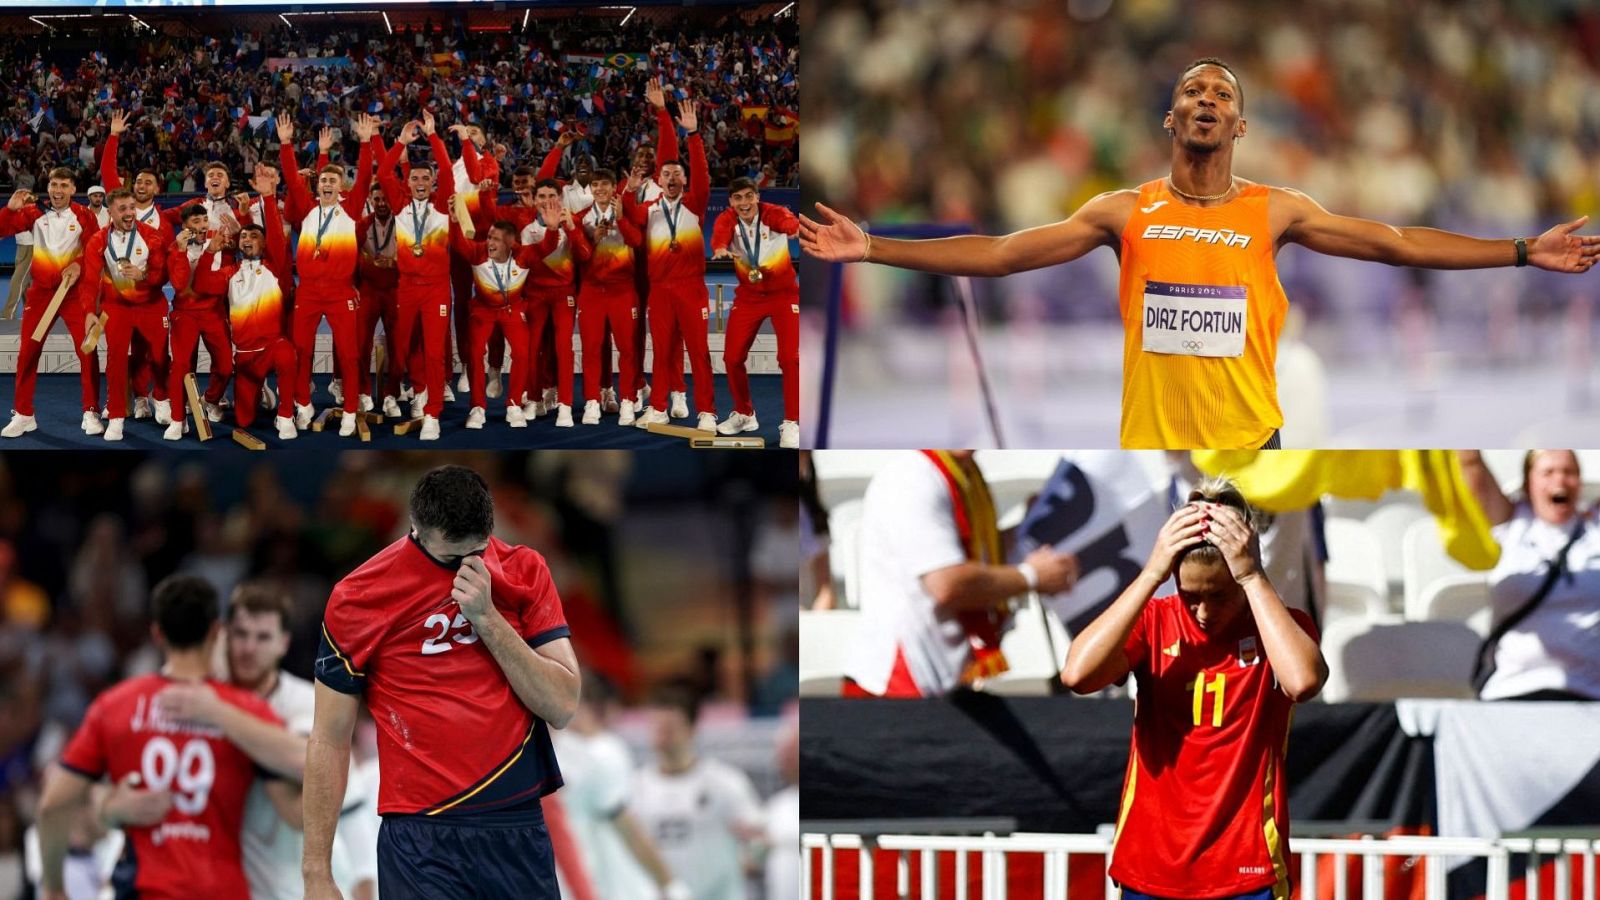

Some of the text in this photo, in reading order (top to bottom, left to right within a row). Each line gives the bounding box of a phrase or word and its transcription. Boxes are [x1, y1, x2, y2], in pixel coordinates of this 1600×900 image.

[1142, 225, 1252, 249] ESPAÑA
[1169, 286, 1221, 296] PARIS 2024
[1146, 306, 1242, 334] DIAZ FORTUN
[421, 613, 479, 655] 25
[1186, 671, 1227, 728] 11
[142, 736, 215, 816] 99
